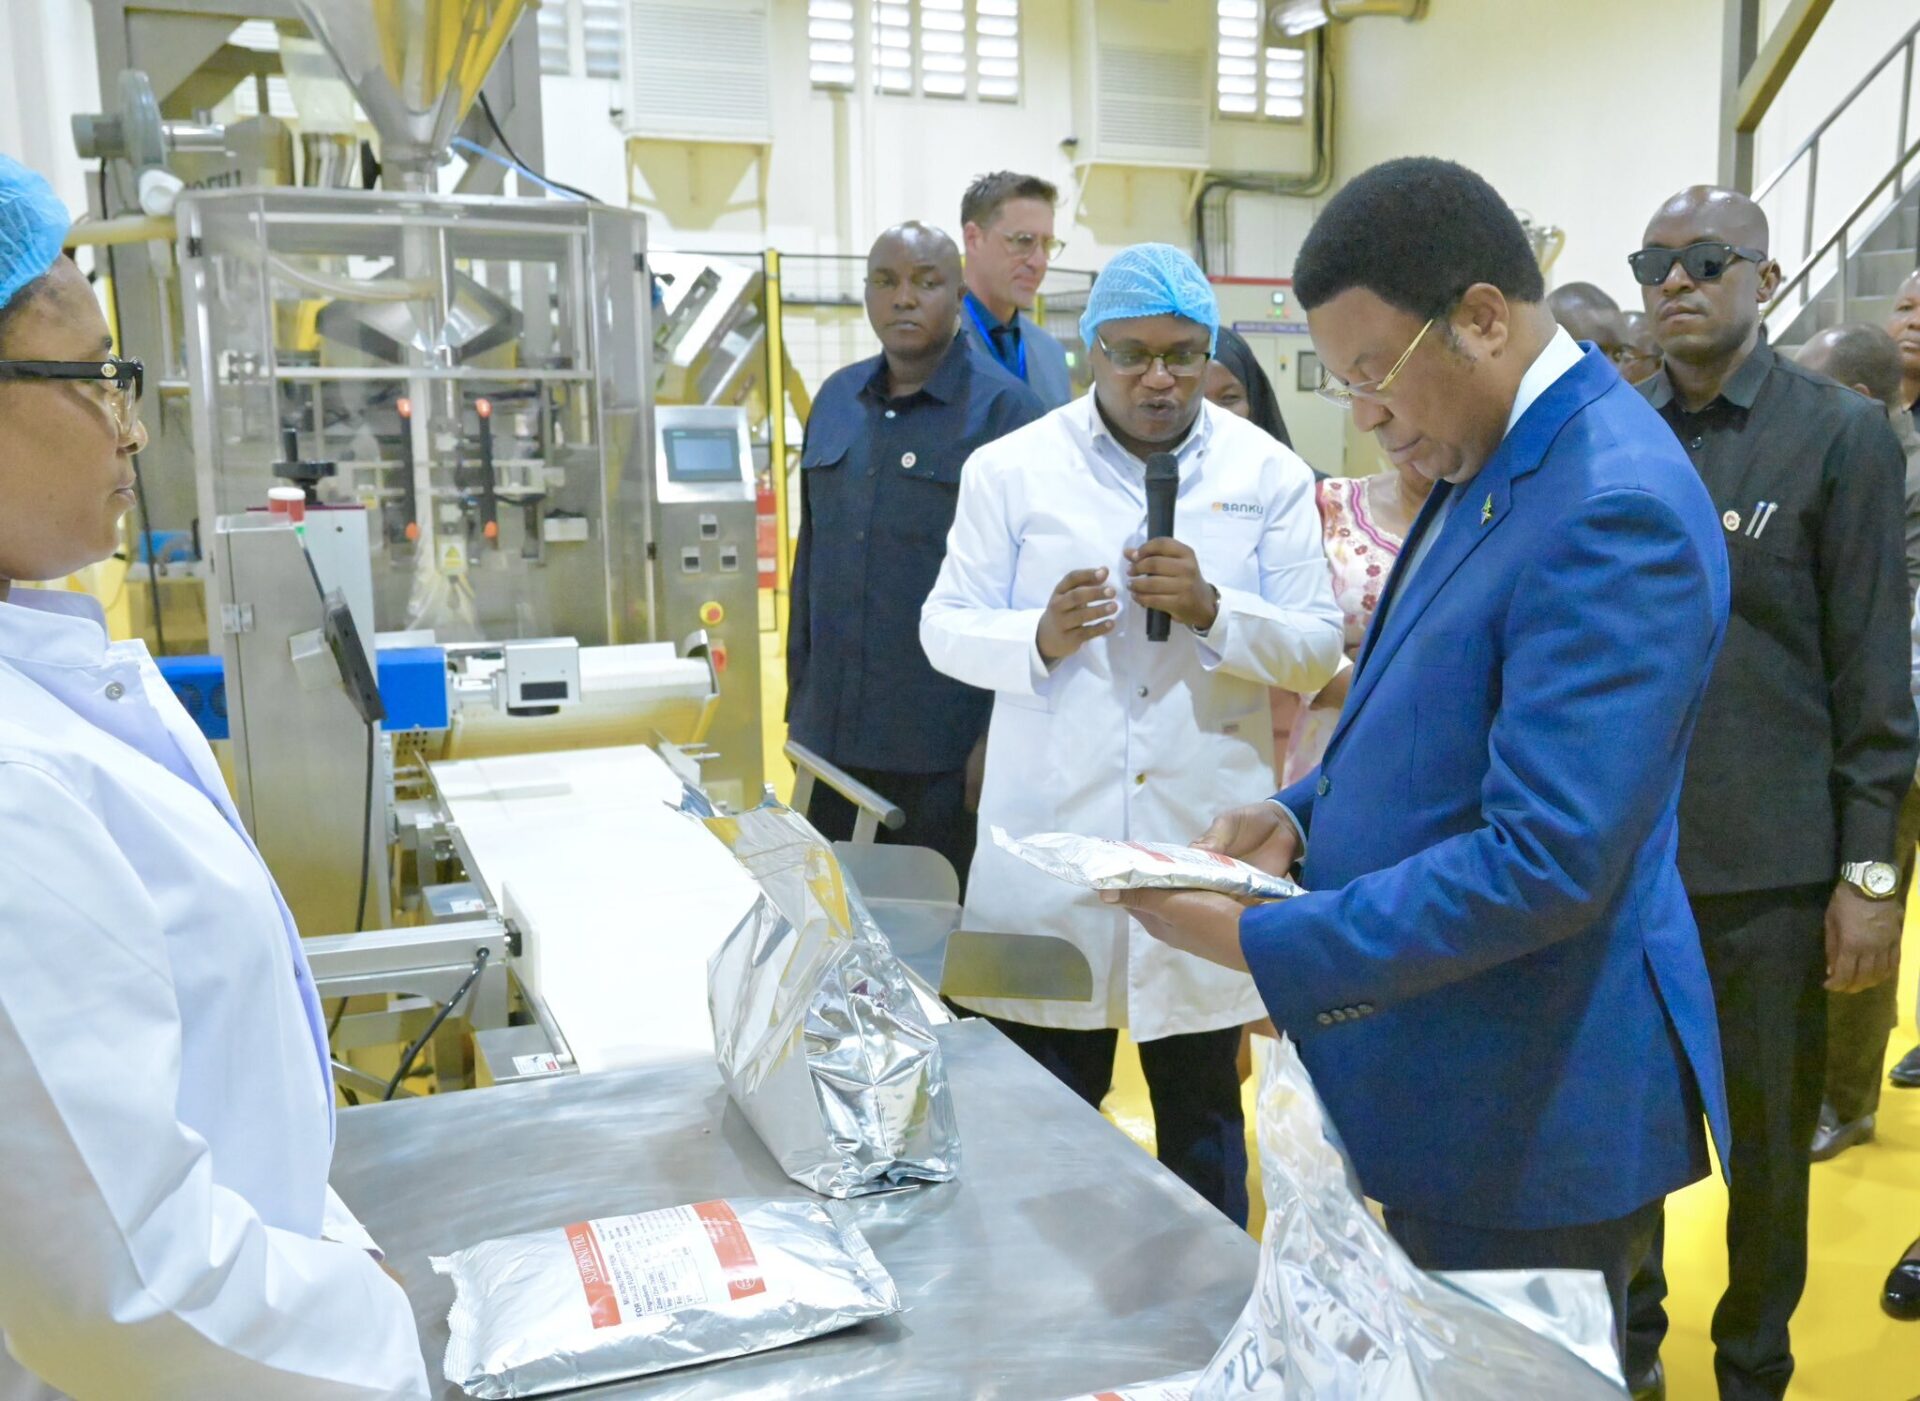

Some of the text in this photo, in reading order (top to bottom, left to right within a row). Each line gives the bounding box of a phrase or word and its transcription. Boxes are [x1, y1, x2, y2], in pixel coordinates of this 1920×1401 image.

[1222, 502, 1264, 515] SANKU
[572, 1232, 599, 1285] SUPERNUTRA
[633, 1302, 644, 1318] FOR
